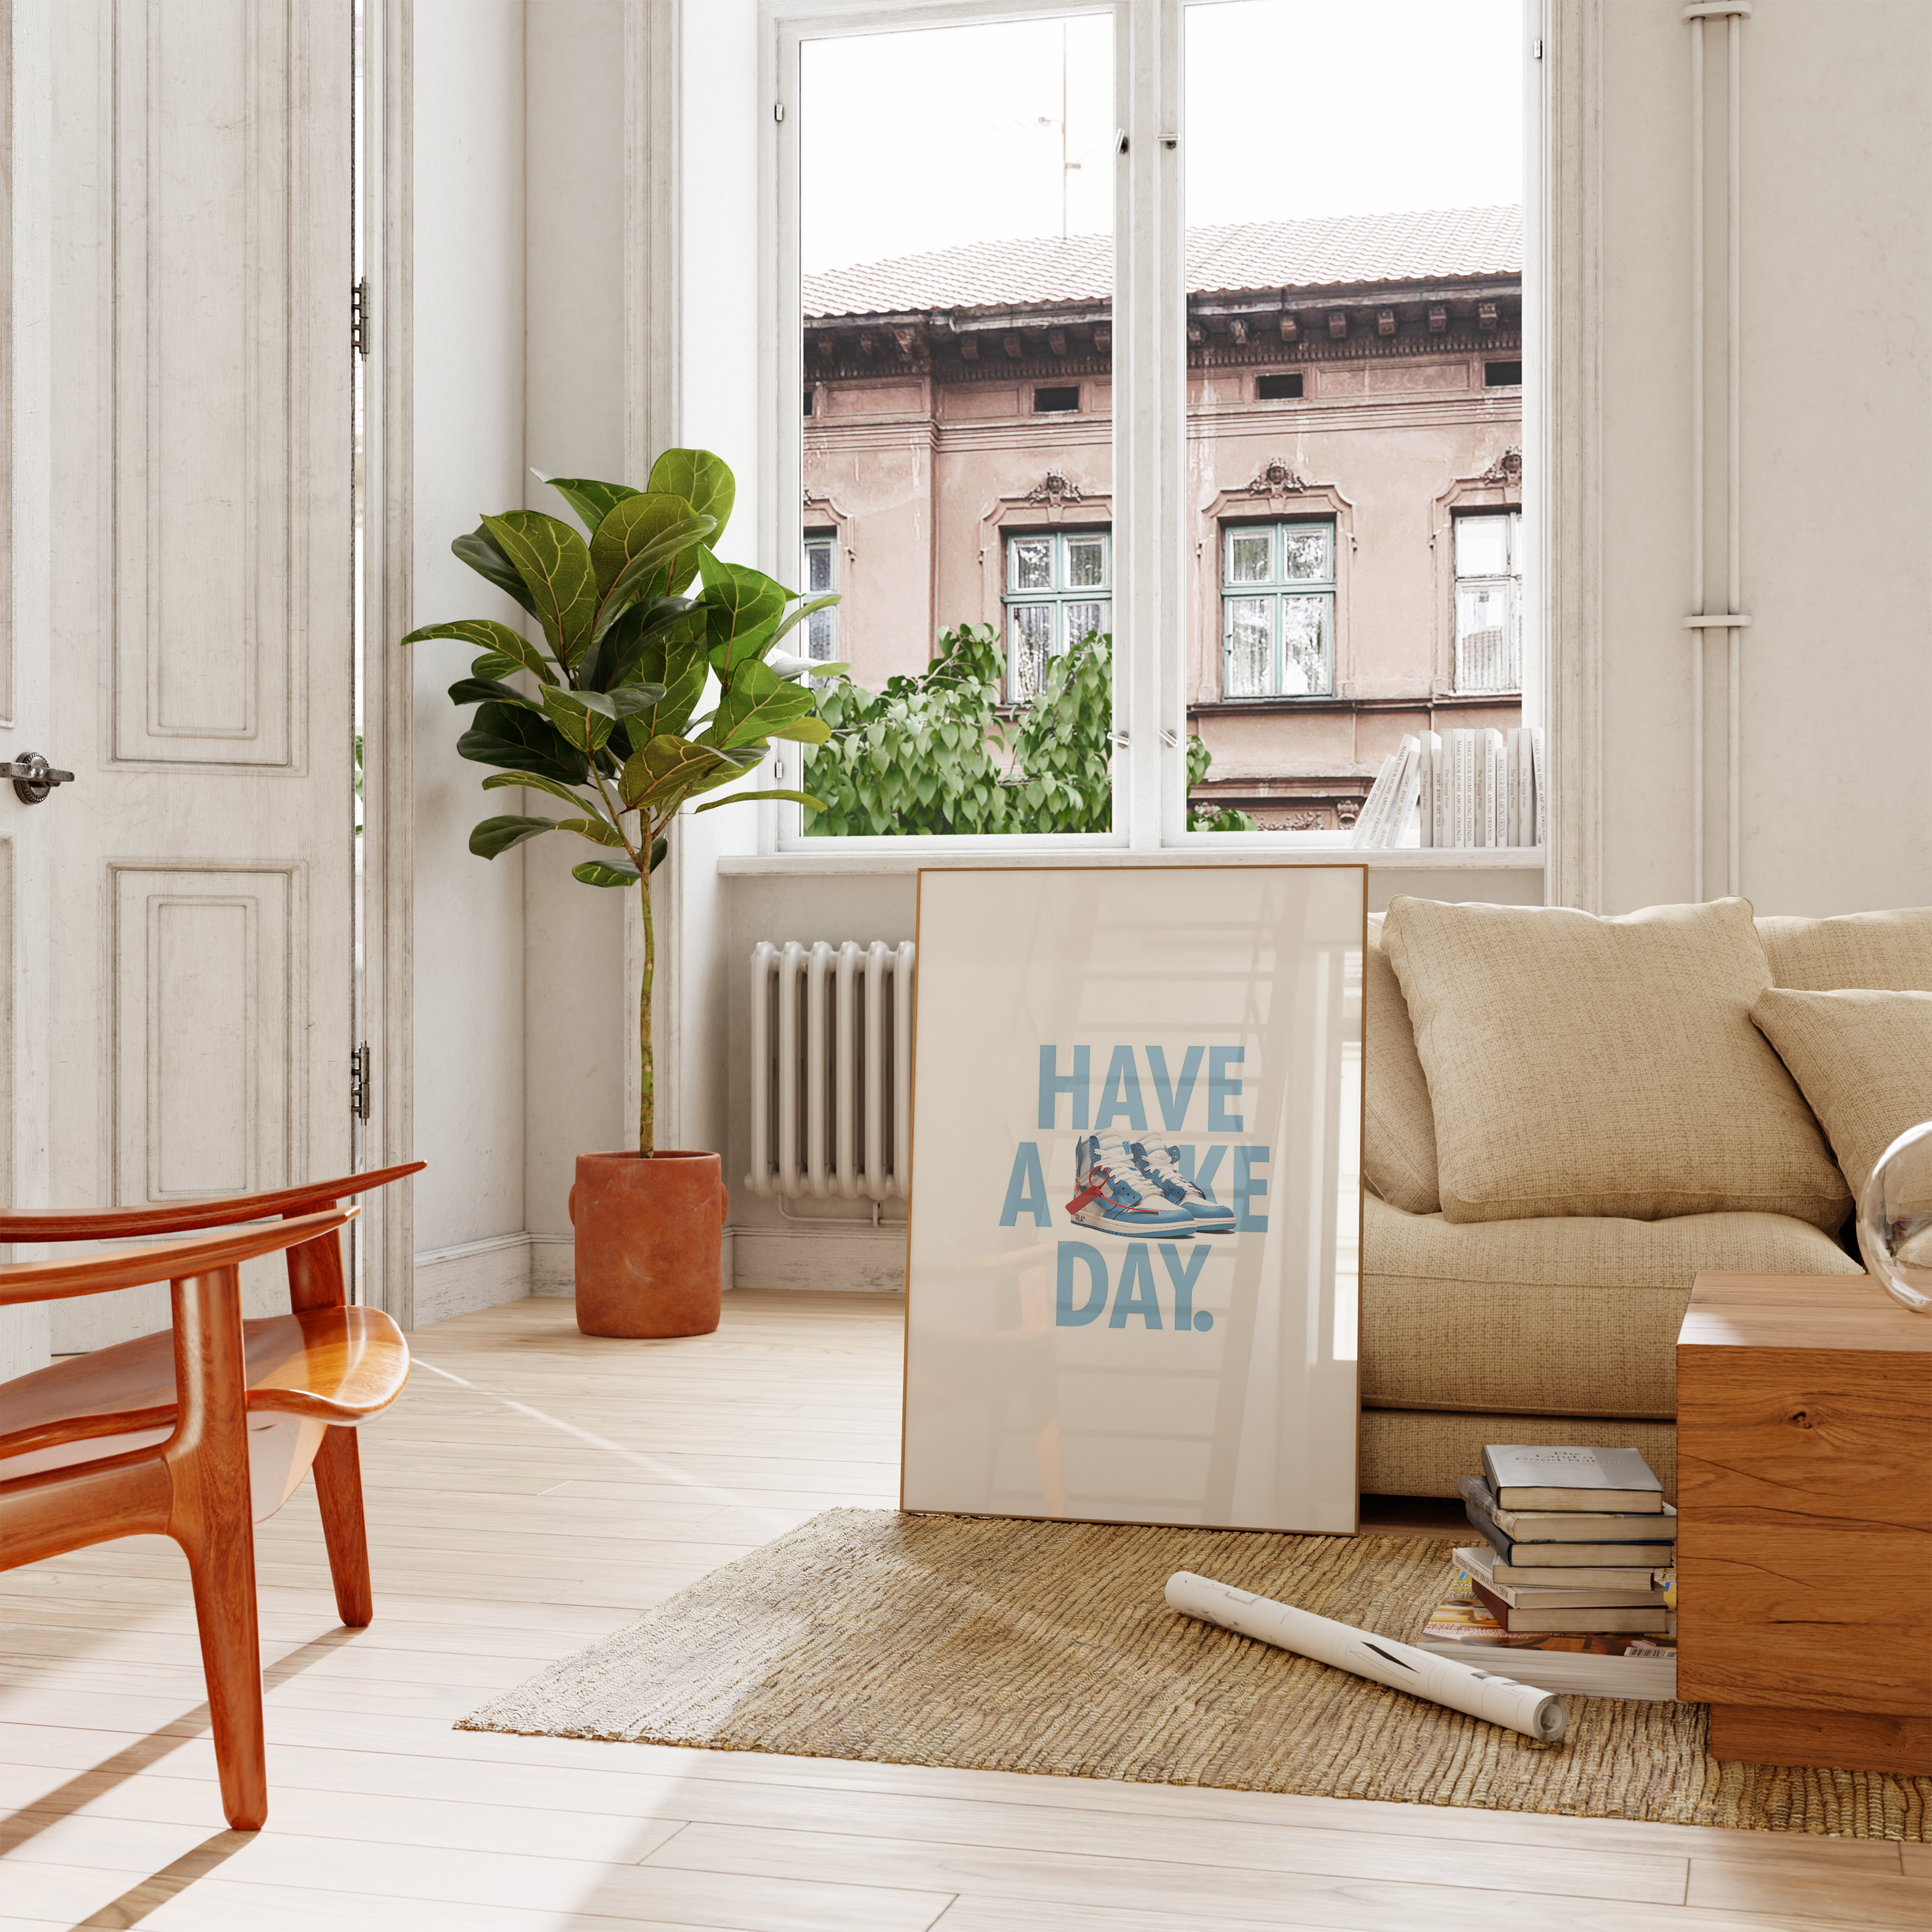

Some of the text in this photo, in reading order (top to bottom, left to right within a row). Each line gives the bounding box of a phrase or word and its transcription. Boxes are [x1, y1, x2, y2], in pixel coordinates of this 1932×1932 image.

[1370, 745, 1407, 841] MAKE YOUR HOME AMONG FRIENDS
[1038, 1045, 1244, 1132] HAVE
[999, 1142, 1270, 1232] A KE
[1056, 1241, 1214, 1332] DAY.
